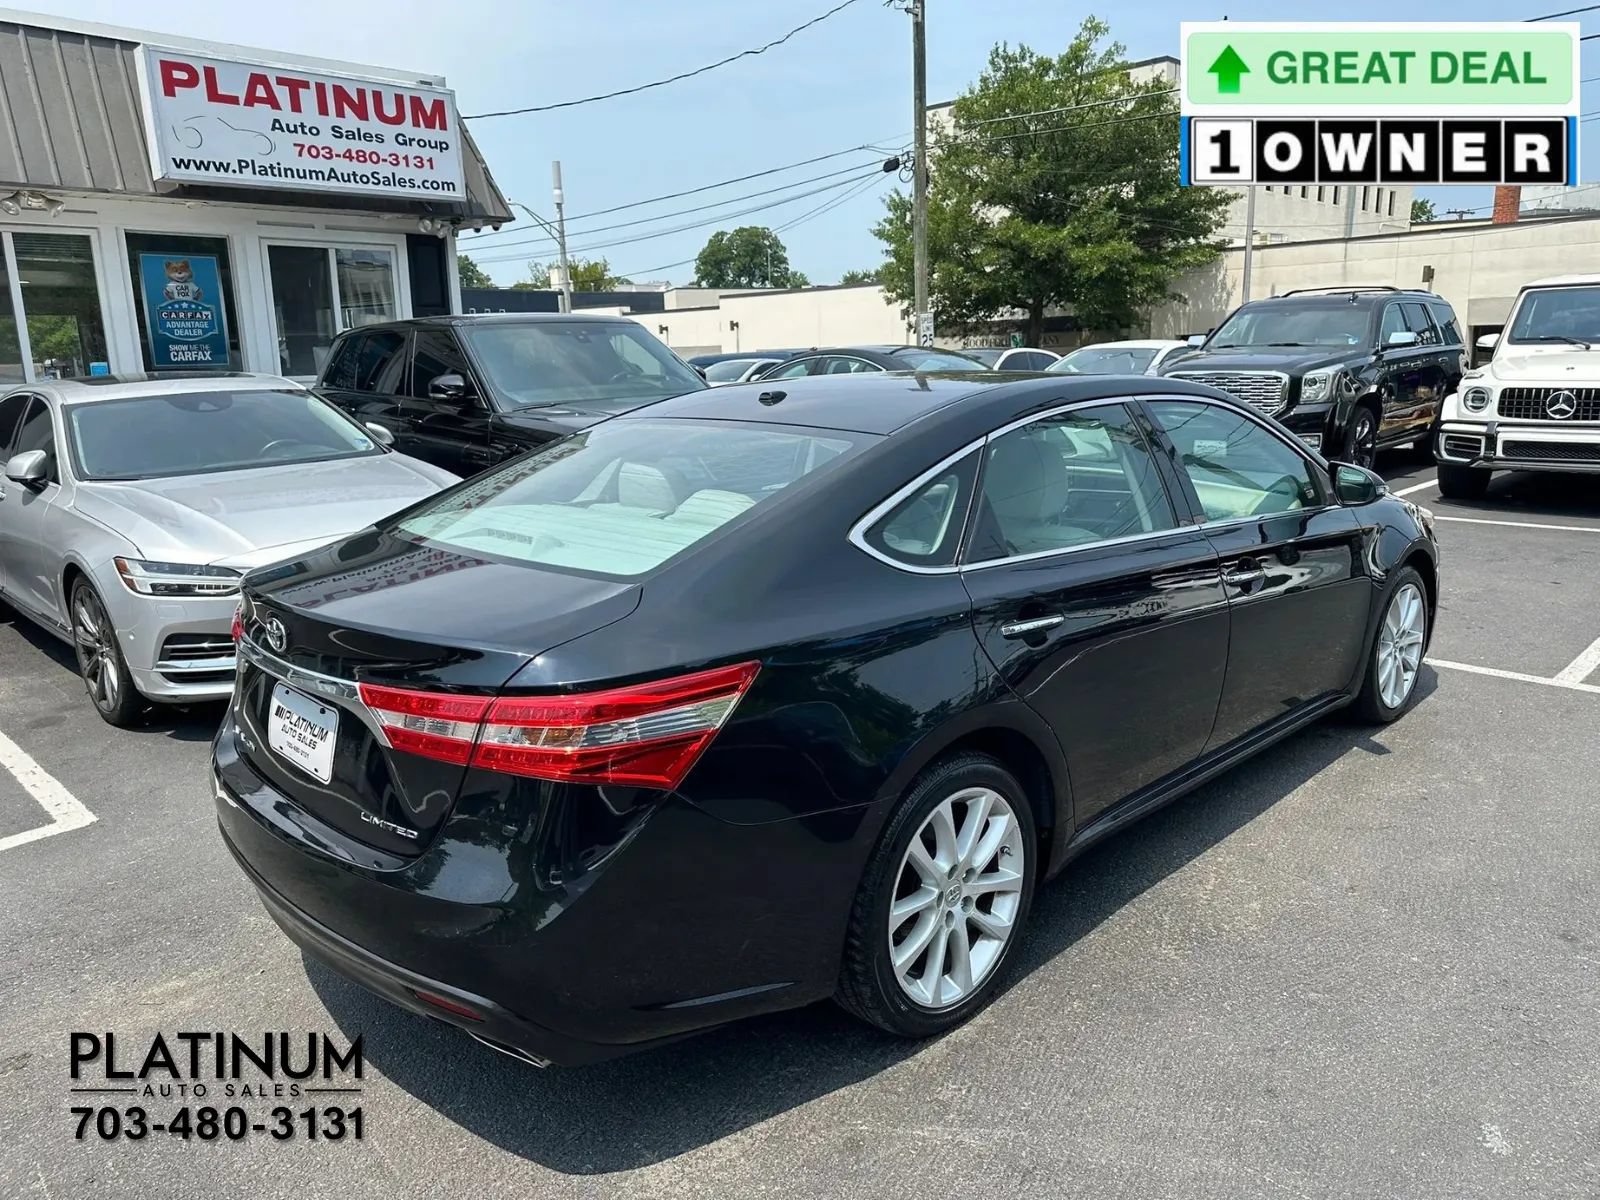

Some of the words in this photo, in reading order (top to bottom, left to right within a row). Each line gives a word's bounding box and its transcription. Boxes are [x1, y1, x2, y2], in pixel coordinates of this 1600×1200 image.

[159, 59, 448, 131] PLATINUM
[270, 118, 320, 137] Auto
[331, 125, 385, 144] Sales
[395, 133, 449, 153] Group
[293, 143, 435, 170] 703-480-3131
[172, 156, 456, 192] www.PlatinumAutoSales.com
[162, 311, 212, 320] CARFAX
[166, 321, 208, 329] ADVANTAGE
[174, 328, 203, 336] DEALER
[170, 351, 212, 361] CARFAX
[281, 724, 297, 739] AUTO
[297, 733, 317, 750] SALES
[283, 711, 329, 743] PLATINUM
[361, 811, 418, 839] LIMITED
